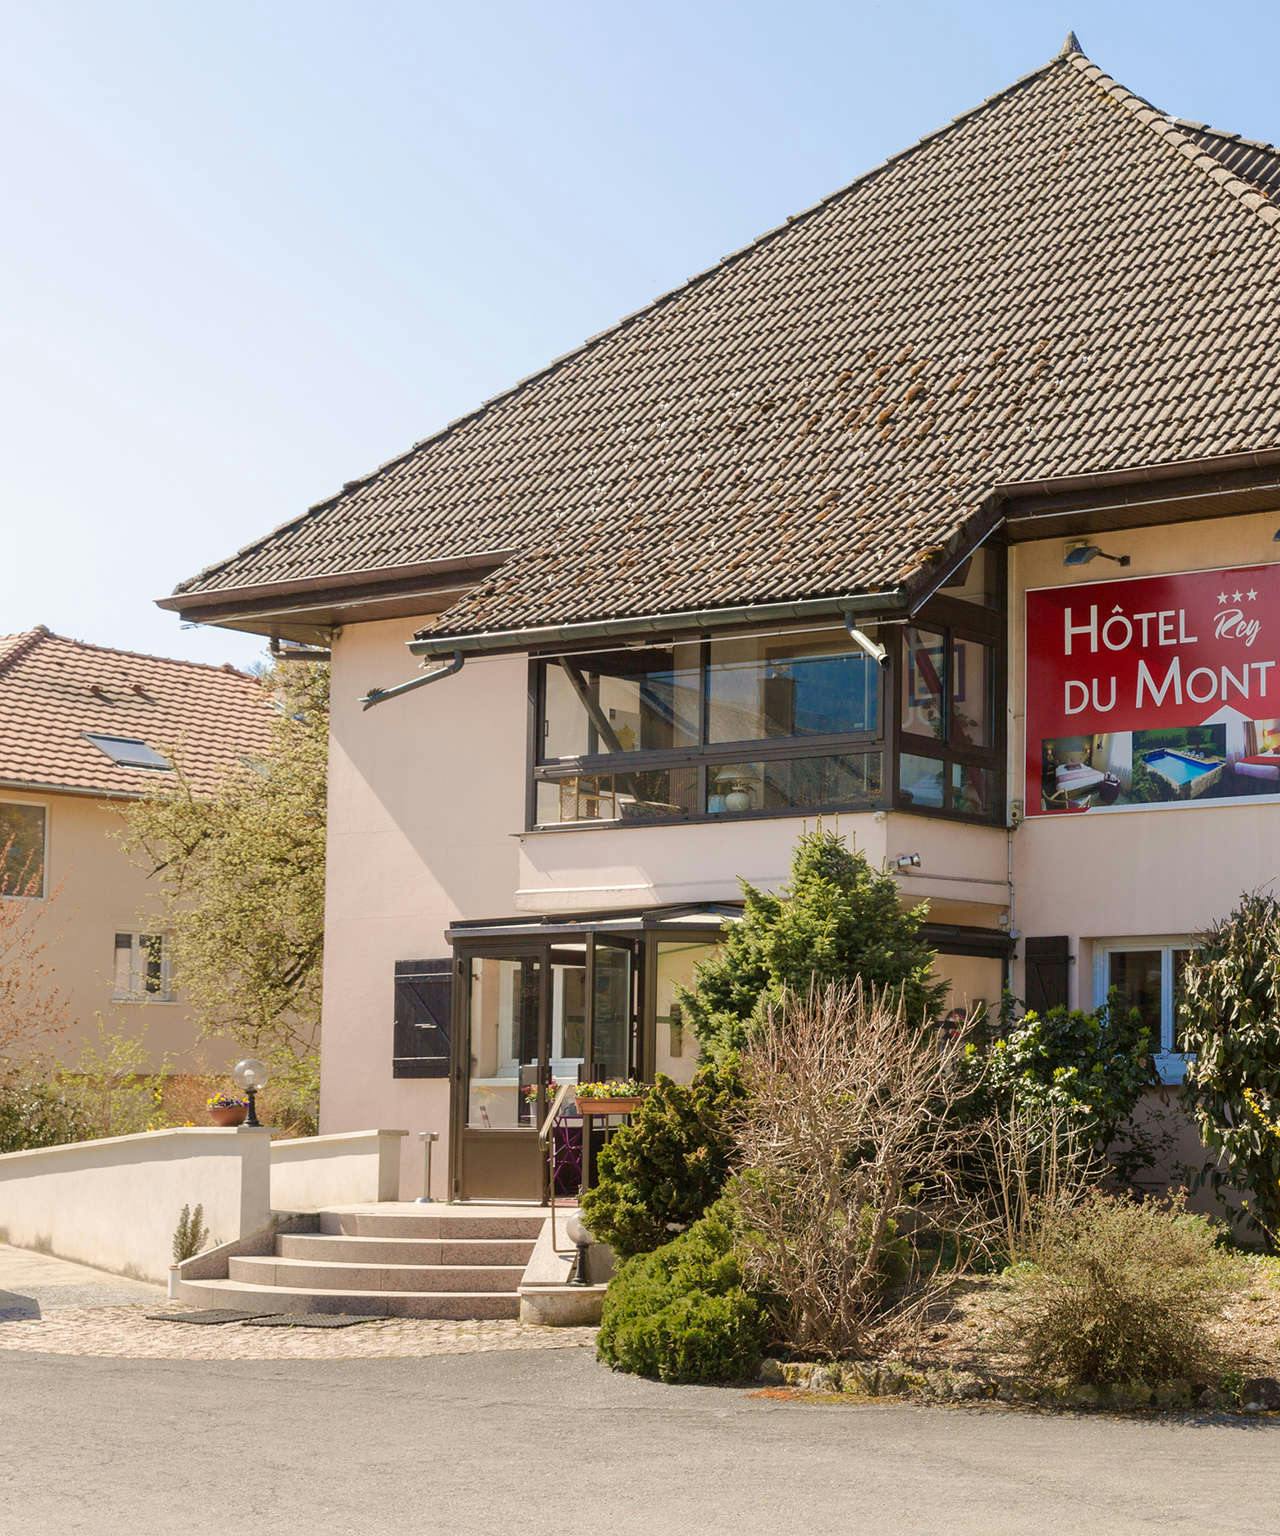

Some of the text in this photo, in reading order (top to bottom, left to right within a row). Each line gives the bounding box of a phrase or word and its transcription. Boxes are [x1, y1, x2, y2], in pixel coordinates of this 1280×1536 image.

[1064, 604, 1262, 655] HÔTEL Rey
[1064, 676, 1117, 715] DU
[1135, 656, 1276, 709] MONT
